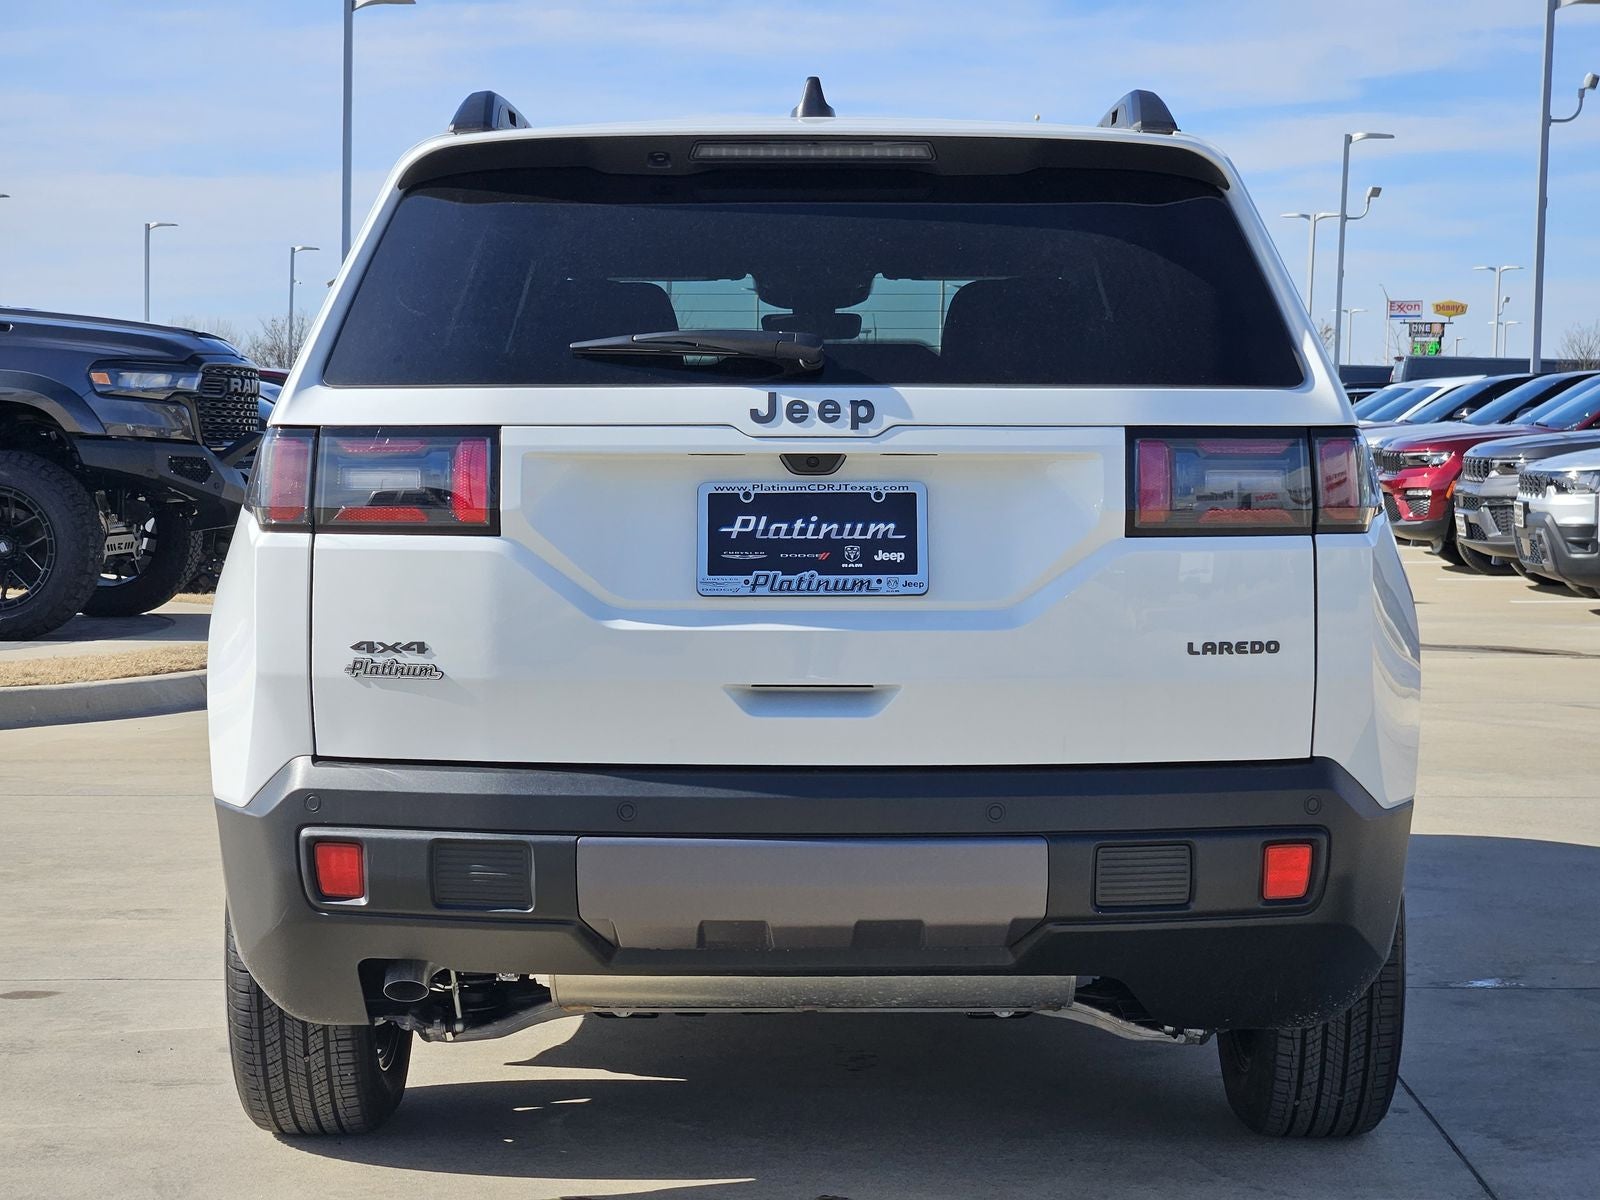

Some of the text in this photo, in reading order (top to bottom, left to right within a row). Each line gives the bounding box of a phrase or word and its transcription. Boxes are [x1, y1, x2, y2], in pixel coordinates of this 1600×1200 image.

[1389, 302, 1420, 313] Exxon
[1435, 304, 1465, 313] Denny's
[750, 391, 875, 430] Jeep
[713, 483, 909, 492] www.PlatinumCDRJTexas.com
[718, 515, 906, 540] Platinum
[873, 550, 905, 563] Jeep
[751, 572, 882, 593] Platinum
[902, 580, 925, 589] Jeep
[1187, 640, 1280, 656] LAREDO
[344, 657, 444, 680] Platinum
